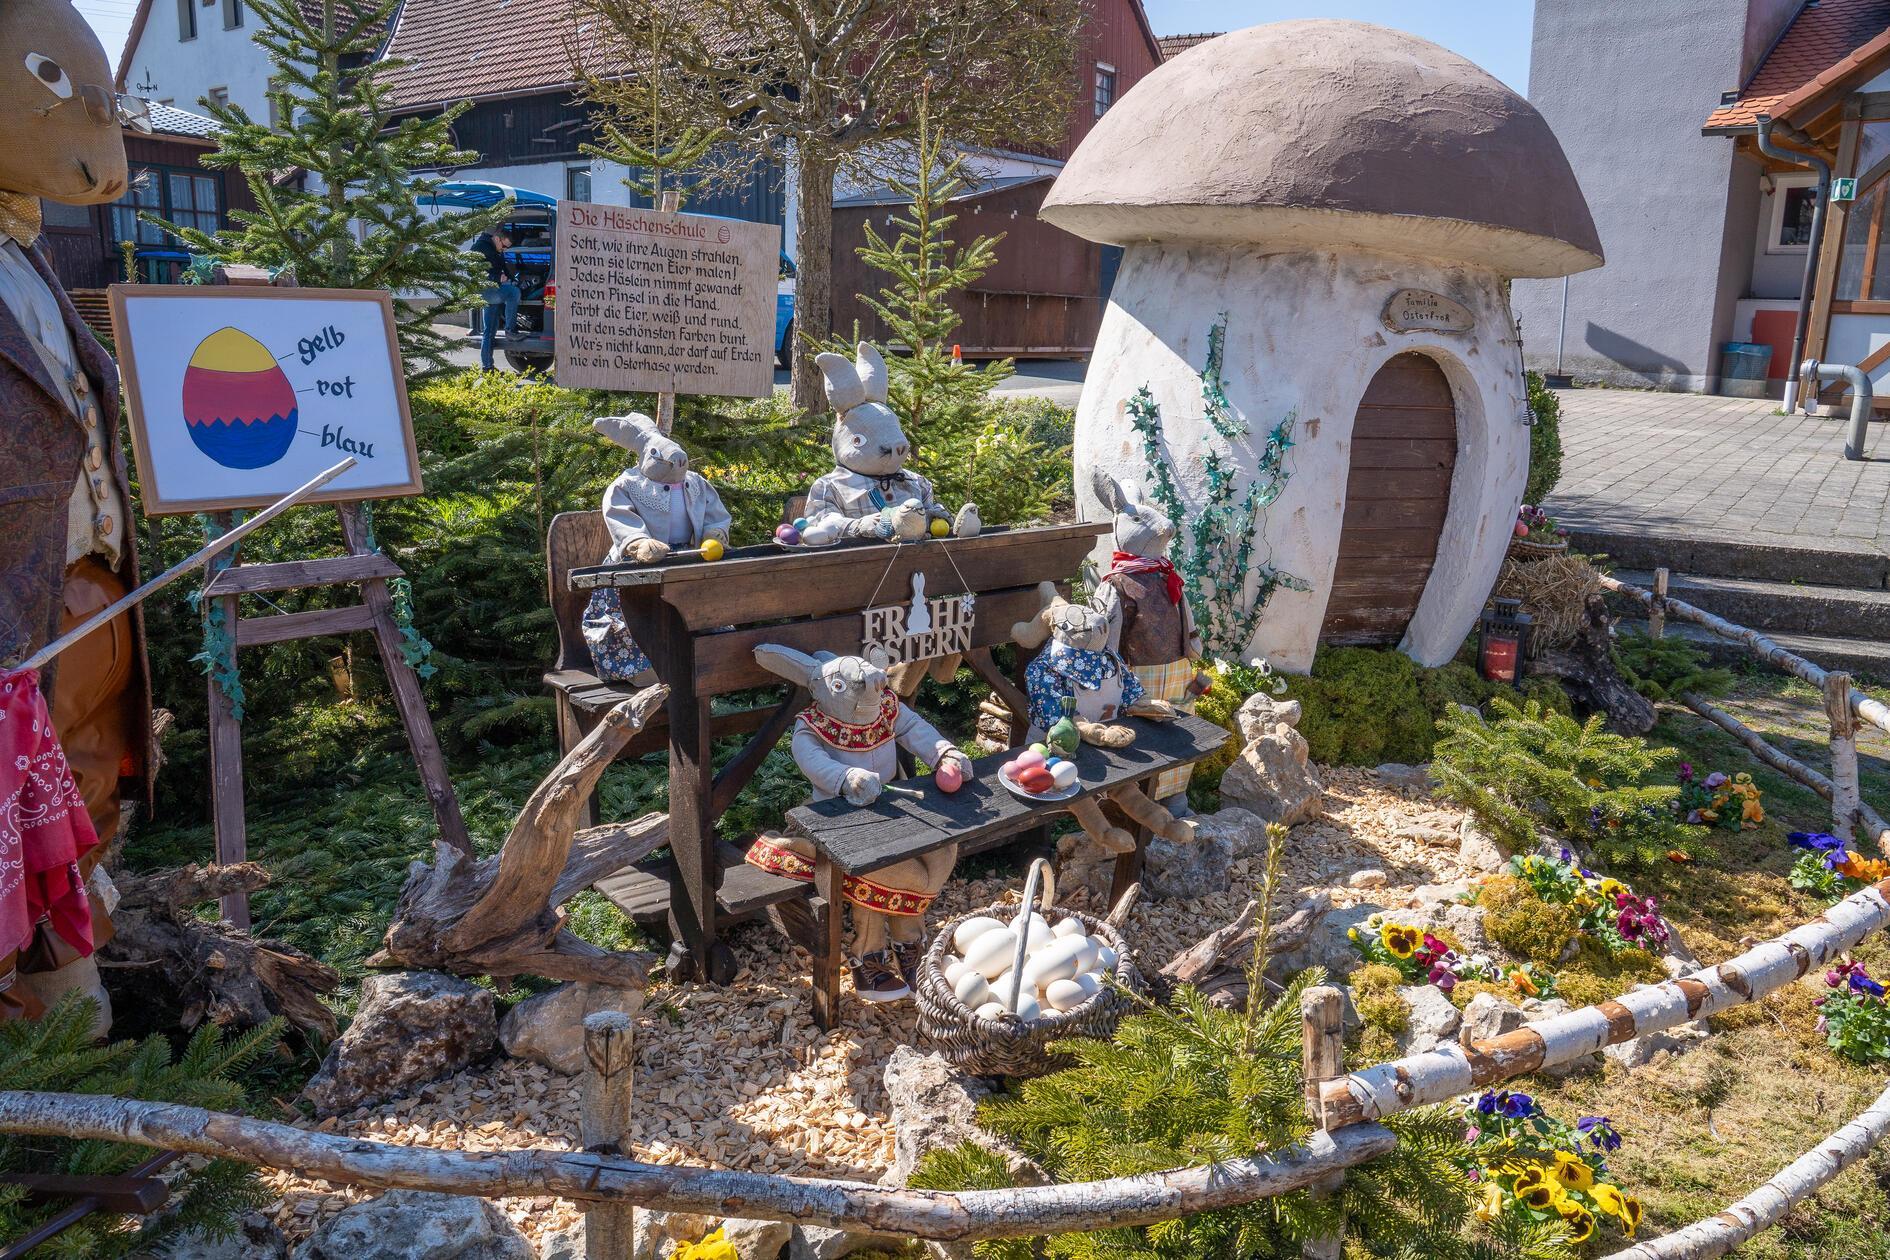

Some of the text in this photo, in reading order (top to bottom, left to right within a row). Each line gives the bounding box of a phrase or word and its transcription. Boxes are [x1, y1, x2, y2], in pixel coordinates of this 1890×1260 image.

[570, 207, 706, 238] Die Häschenschule
[570, 234, 601, 251] Seht,
[602, 240, 623, 252] wie
[626, 241, 648, 255] ihre
[651, 243, 688, 261] Augen
[572, 255, 737, 281] wenn sie lernen Eier malen!
[570, 267, 742, 296] Jedes Häslein nimmt gewandt
[571, 285, 605, 300] einen
[610, 288, 644, 303] Pinsel
[649, 292, 659, 305] in
[663, 293, 680, 307] die
[570, 302, 600, 319] färbt
[604, 304, 621, 319] die
[652, 311, 680, 325] weiß
[685, 311, 707, 326] und
[572, 320, 591, 333] mit
[595, 322, 616, 336] den
[618, 324, 676, 340] schönsten
[679, 327, 721, 342] Farben
[298, 325, 345, 366] gelb
[606, 339, 633, 353] nicht
[667, 344, 686, 357] der
[688, 346, 710, 359] darf
[711, 348, 728, 362] auf
[731, 348, 761, 362] Erden
[570, 355, 718, 375] nie ein Osterhase werden.
[316, 376, 356, 399] rot
[320, 424, 374, 458] blau
